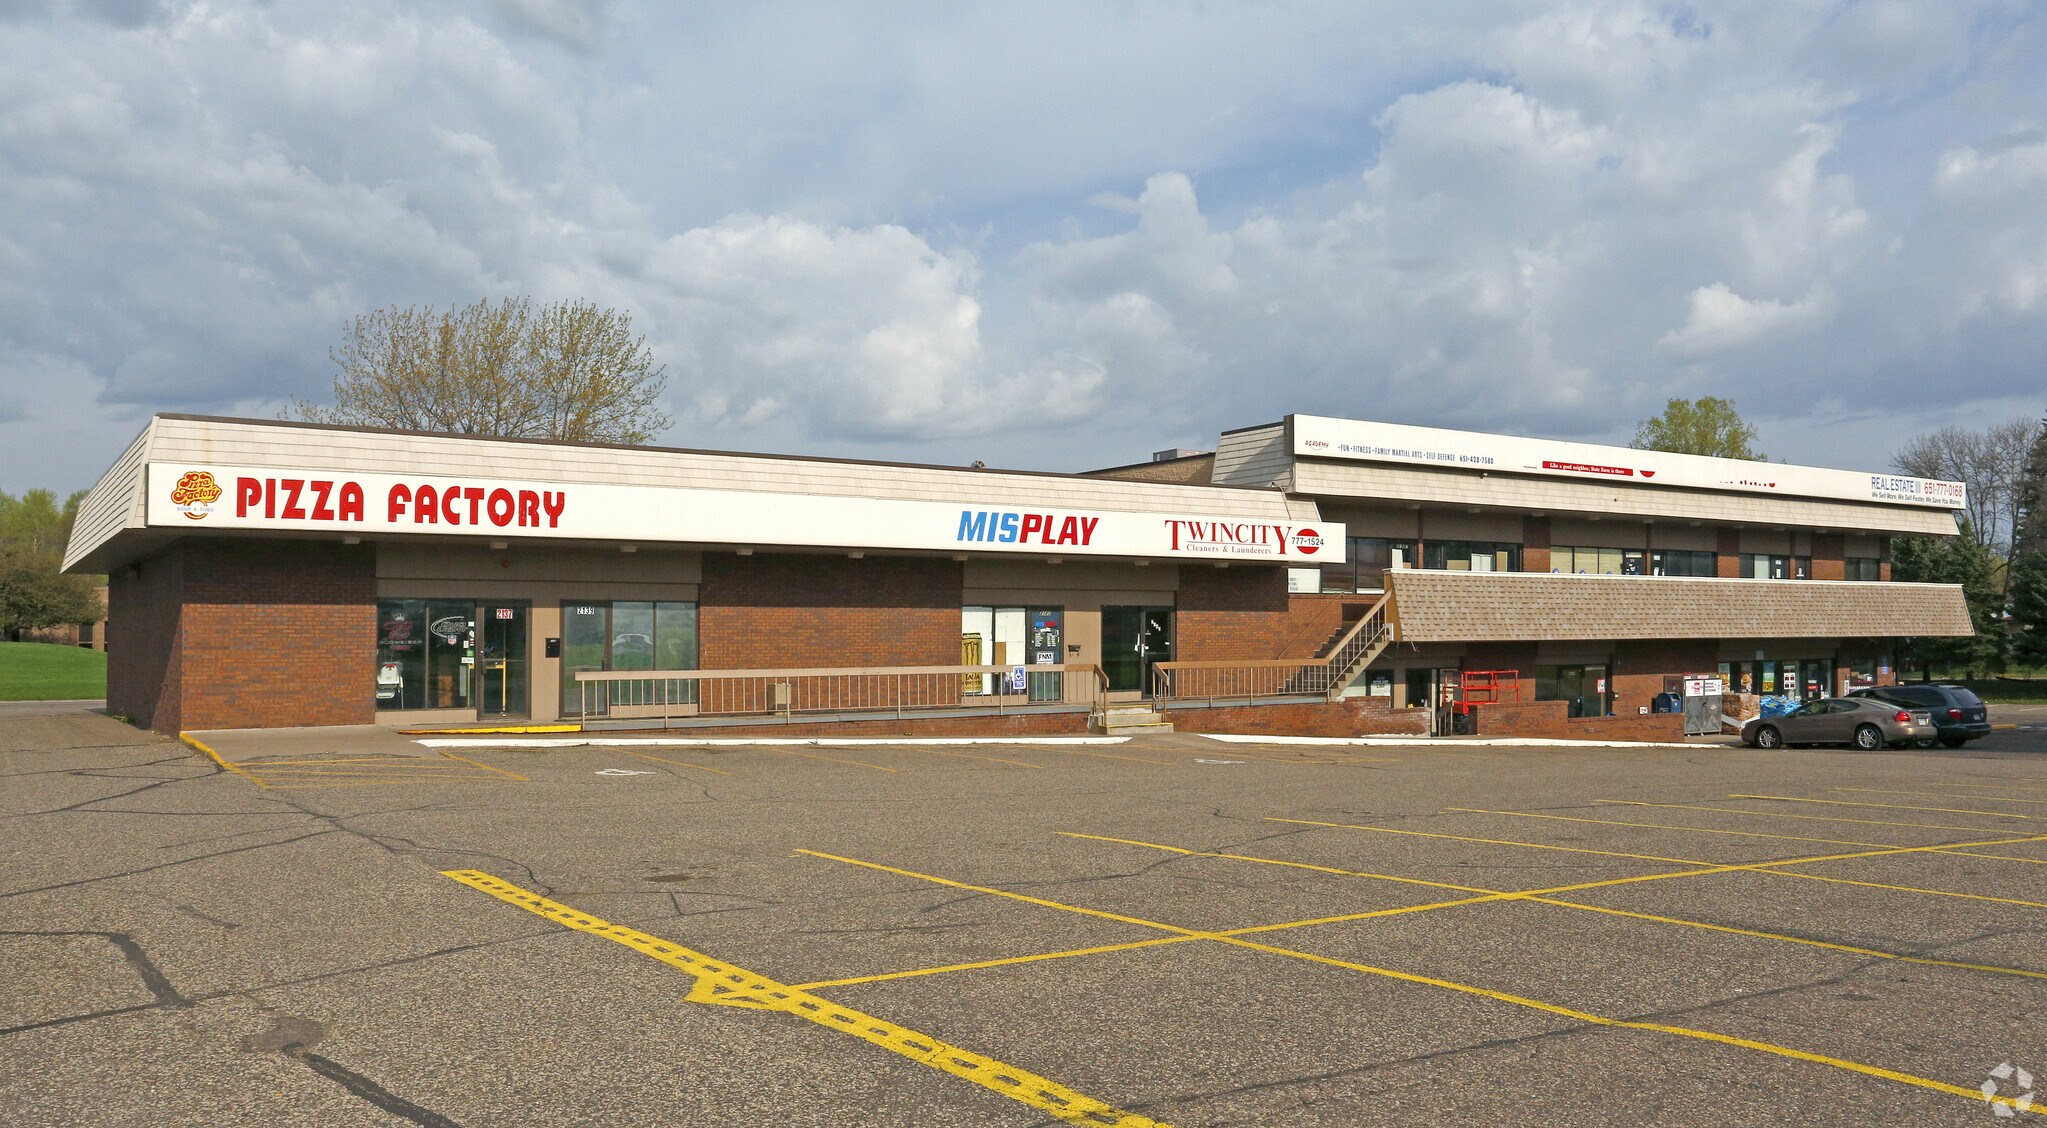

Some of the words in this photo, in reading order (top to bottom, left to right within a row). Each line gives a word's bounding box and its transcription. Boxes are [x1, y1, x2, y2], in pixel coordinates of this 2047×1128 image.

[1305, 440, 1329, 449] ACADEMY
[1392, 448, 1410, 458] MARTIAL
[1411, 450, 1423, 459] ARTS
[1437, 453, 1455, 462] DEFENSE
[180, 473, 213, 489] Pizza
[1871, 476, 1889, 491] REAL
[1890, 478, 1915, 493] ESTATE
[1924, 482, 1963, 498] 651-777-0168
[173, 486, 219, 502] Factory
[236, 477, 364, 521] PIZZA
[388, 484, 567, 528] FACTORY
[1949, 498, 1961, 507] Money
[957, 510, 1099, 546] MISPLAY
[1165, 519, 1292, 555] TWINCITY
[1291, 537, 1324, 546] 777-1524
[1186, 544, 1219, 552] Cleaners
[1231, 546, 1272, 554] Launderers
[496, 609, 513, 620] 2137
